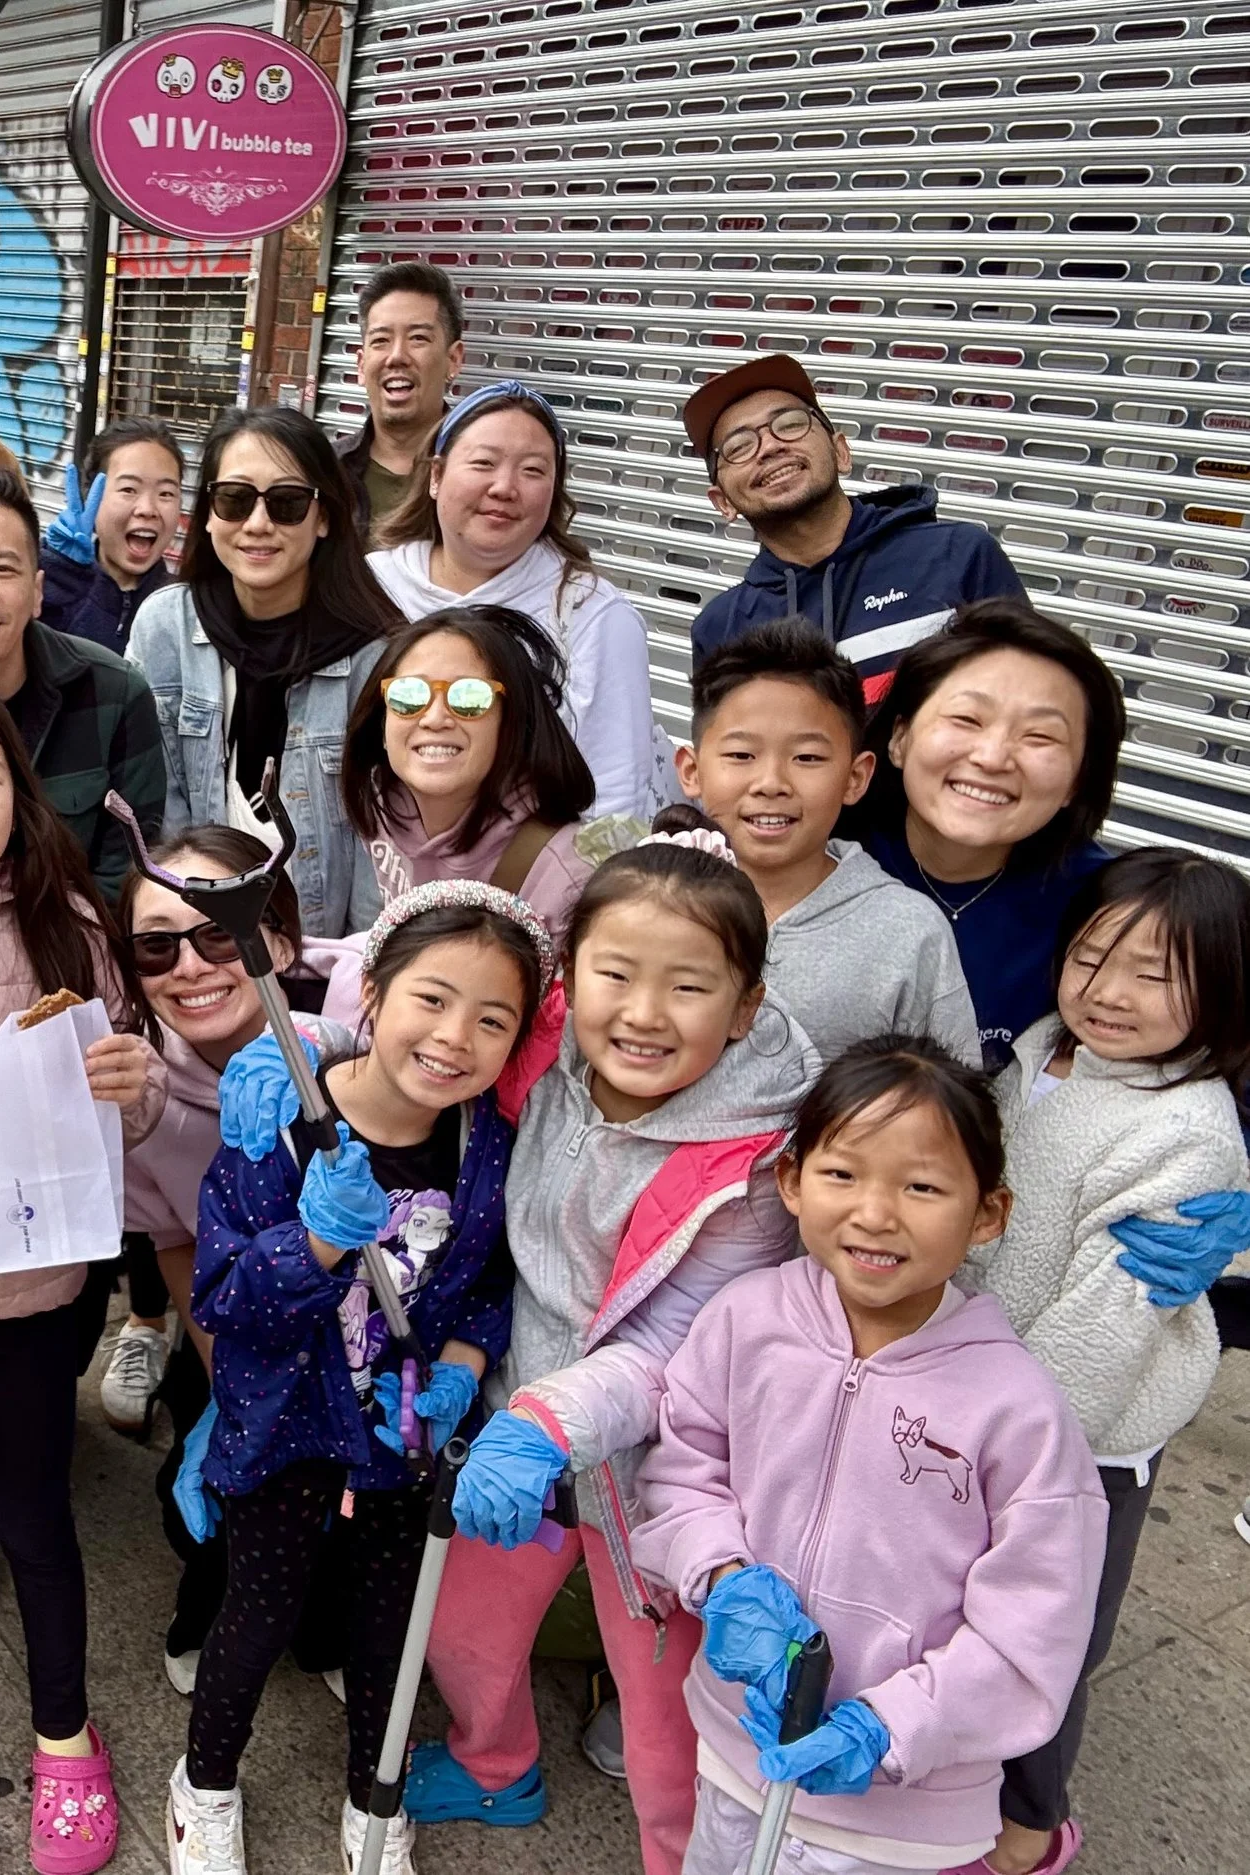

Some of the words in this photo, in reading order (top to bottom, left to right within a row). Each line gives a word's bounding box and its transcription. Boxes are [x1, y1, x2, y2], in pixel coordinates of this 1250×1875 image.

[128, 113, 218, 150] VIVI
[221, 132, 282, 154] bubble
[284, 137, 313, 156] tea
